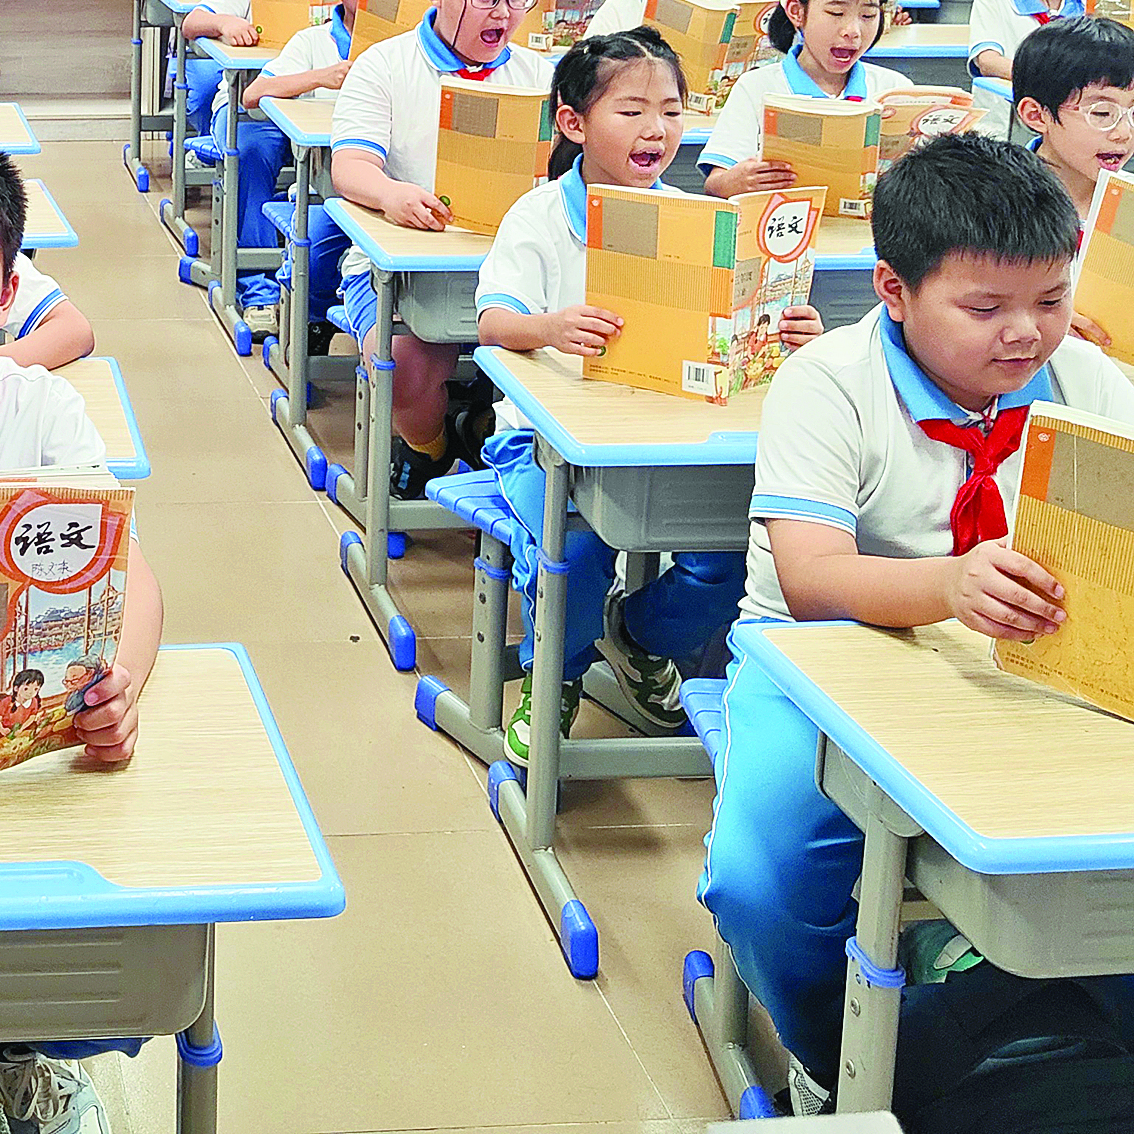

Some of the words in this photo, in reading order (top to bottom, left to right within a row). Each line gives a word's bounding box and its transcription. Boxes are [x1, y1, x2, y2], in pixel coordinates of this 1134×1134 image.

[922, 114, 961, 126] 语文
[767, 215, 804, 239] 语文
[14, 520, 96, 557] 语文
